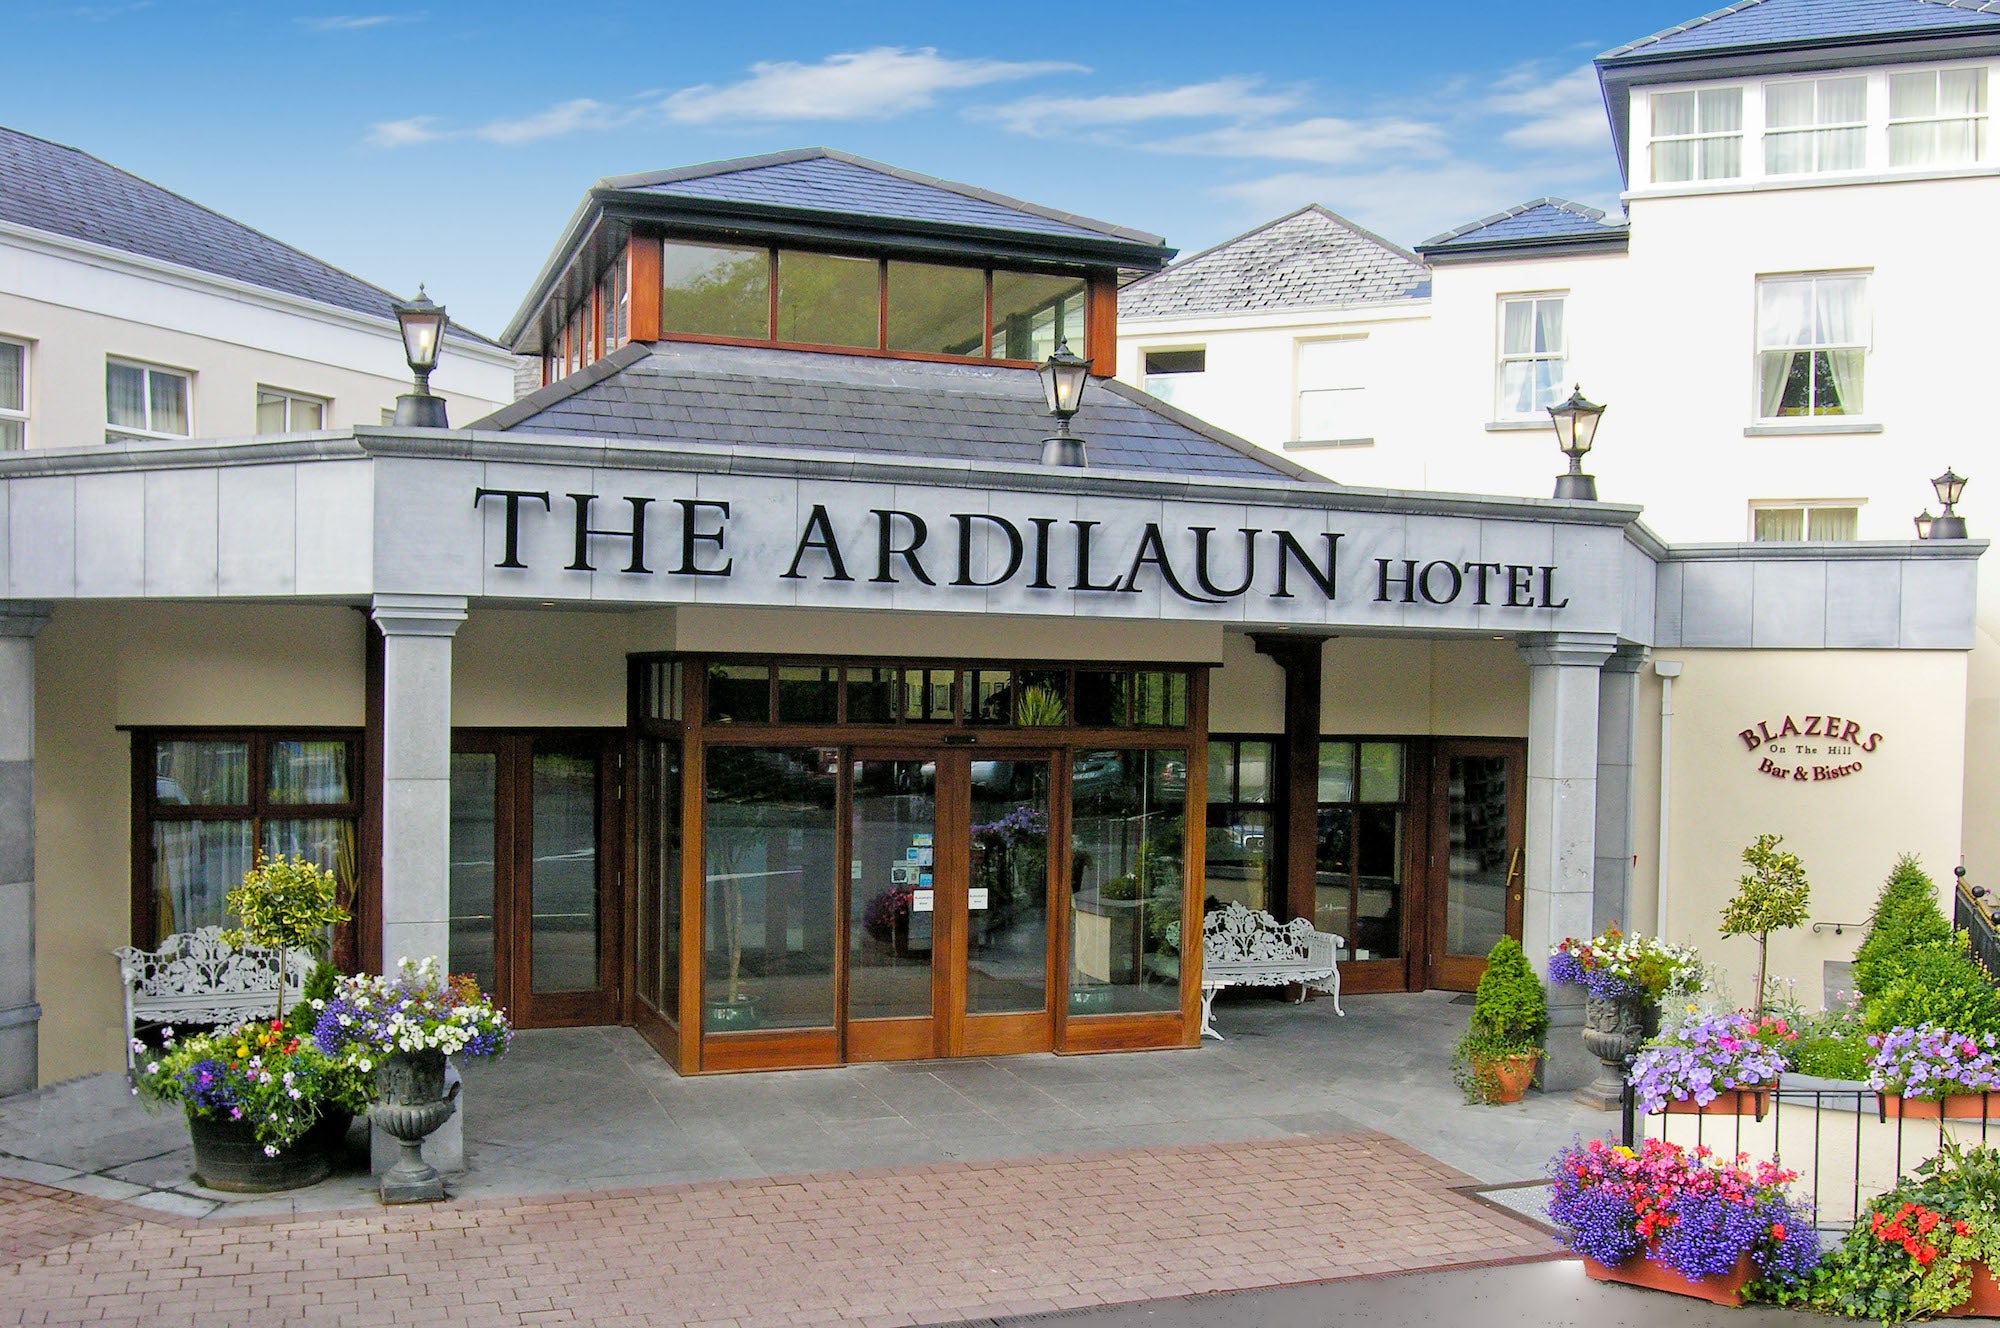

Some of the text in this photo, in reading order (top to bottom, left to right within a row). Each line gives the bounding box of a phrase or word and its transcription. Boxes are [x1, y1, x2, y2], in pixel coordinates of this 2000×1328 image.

[475, 487, 1570, 608] THE ARDILAUN HOTEL
[1738, 715, 1884, 753] BLAZERS
[1769, 744, 1852, 755] On The Hill
[1758, 757, 1863, 781] Bar & Bistro
